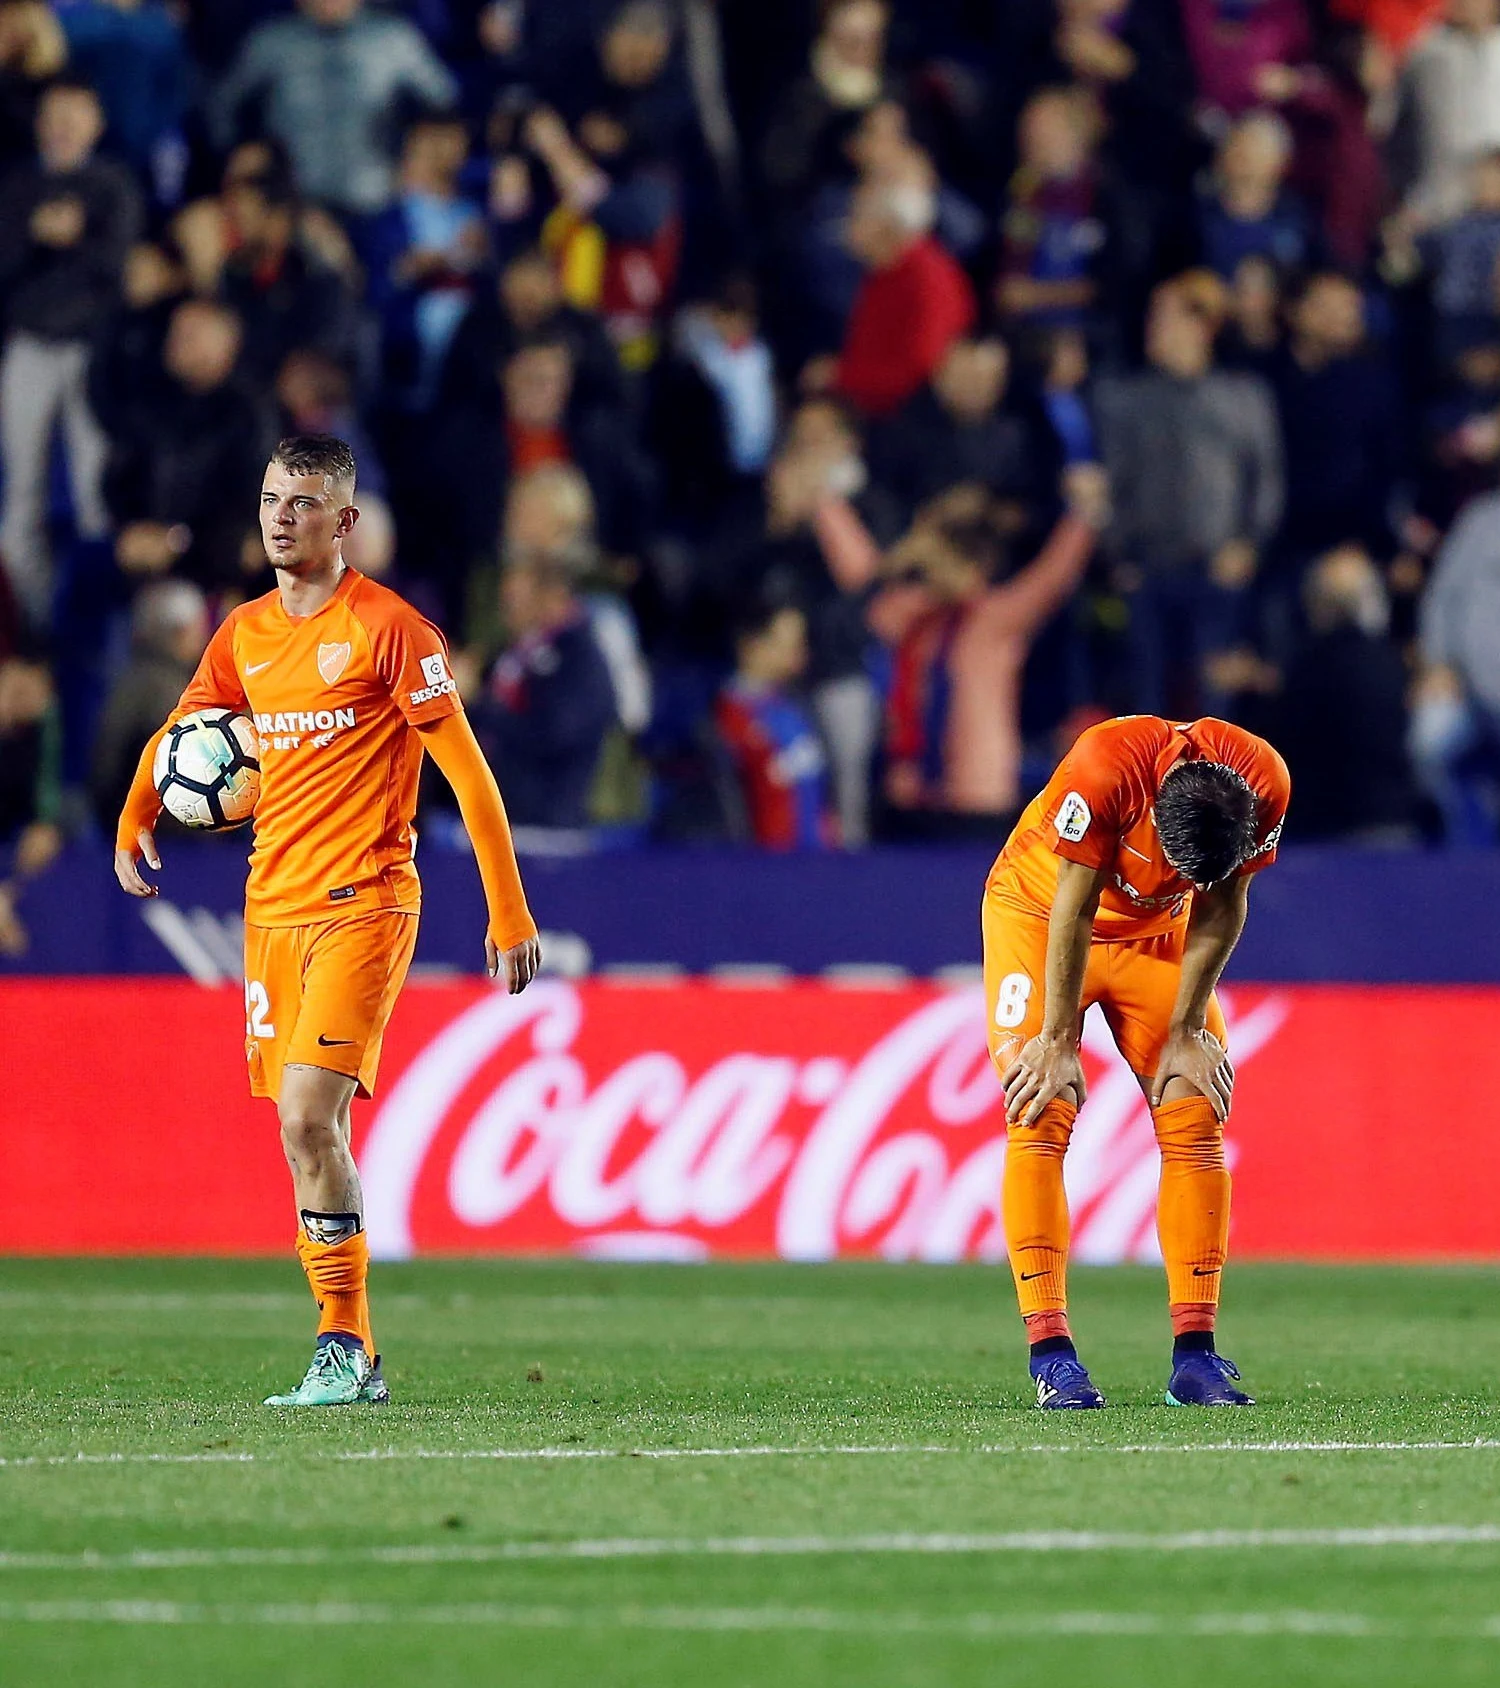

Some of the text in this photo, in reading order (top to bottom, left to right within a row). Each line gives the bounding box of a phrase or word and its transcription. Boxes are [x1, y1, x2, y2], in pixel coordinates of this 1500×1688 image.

[253, 708, 356, 734] RATHON
[273, 737, 300, 750] BET
[995, 972, 1032, 1028] 8
